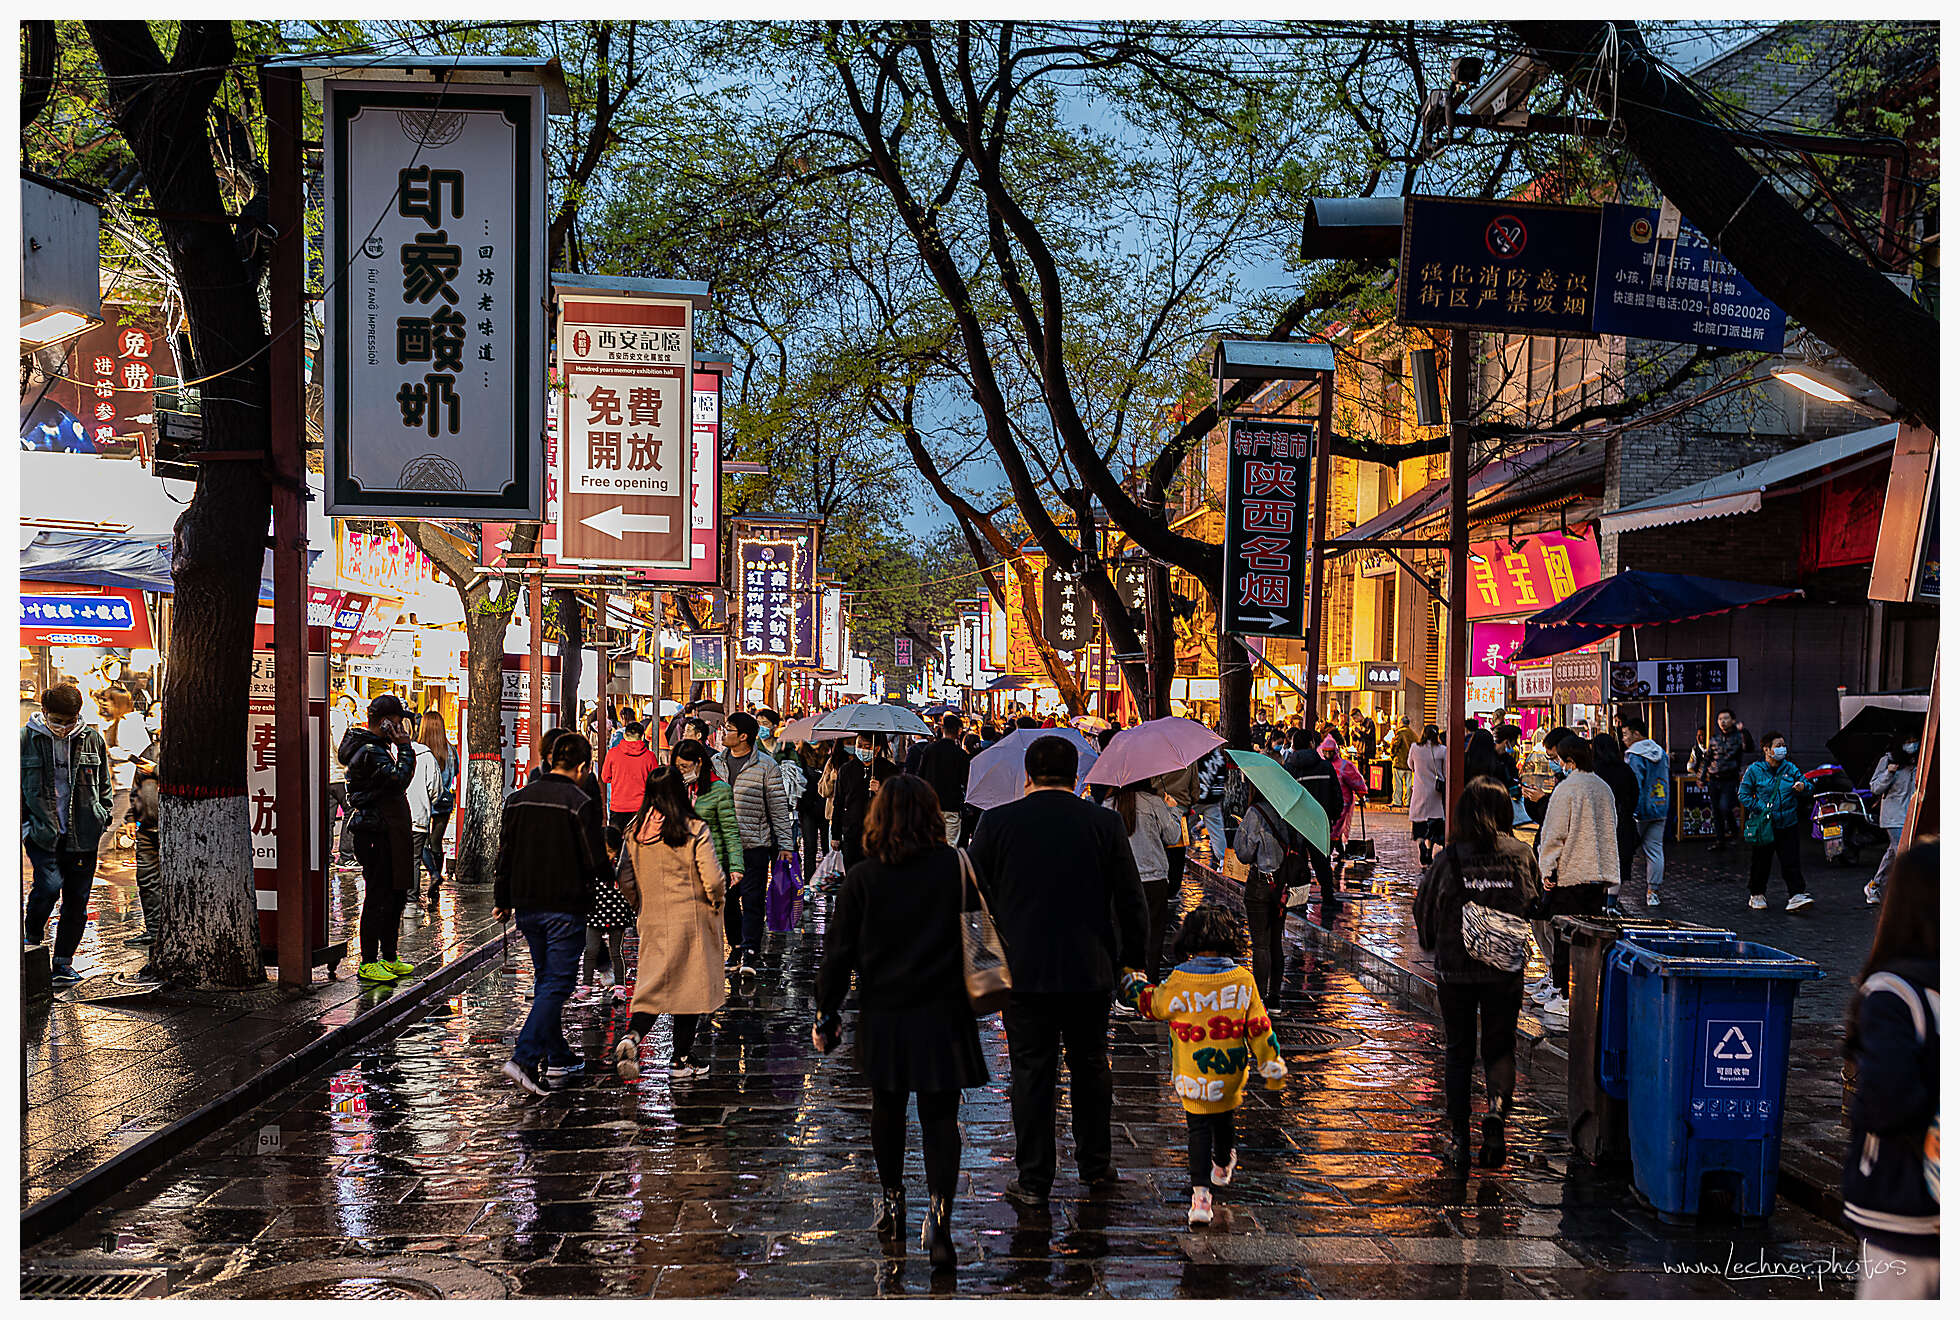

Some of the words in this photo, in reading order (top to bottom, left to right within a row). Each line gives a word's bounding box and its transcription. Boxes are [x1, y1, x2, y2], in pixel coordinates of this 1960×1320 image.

[1419, 262, 1588, 292] 强化消防意识
[396, 165, 468, 438] 印家酸奶
[1418, 284, 1587, 316] 街区严禁吸烟
[598, 330, 681, 352] 西安記憶
[1692, 321, 1765, 341] 北院门派出所
[118, 330, 149, 391] 免费
[575, 365, 599, 374] Hundred
[600, 367, 613, 376] years
[614, 368, 636, 376] memory
[637, 368, 663, 376] exhibition
[664, 368, 674, 376] hall
[608, 351, 671, 362] 西安历史文化展览馆
[95, 357, 116, 444] 进馆参观
[586, 384, 663, 428] 免費
[586, 431, 664, 473] 開放
[1234, 429, 1308, 459] 特产超市
[581, 475, 610, 488] Free
[614, 477, 669, 492] opening
[1239, 460, 1297, 608] 陕西名烟
[1716, 1067, 1750, 1076] 可回收物
